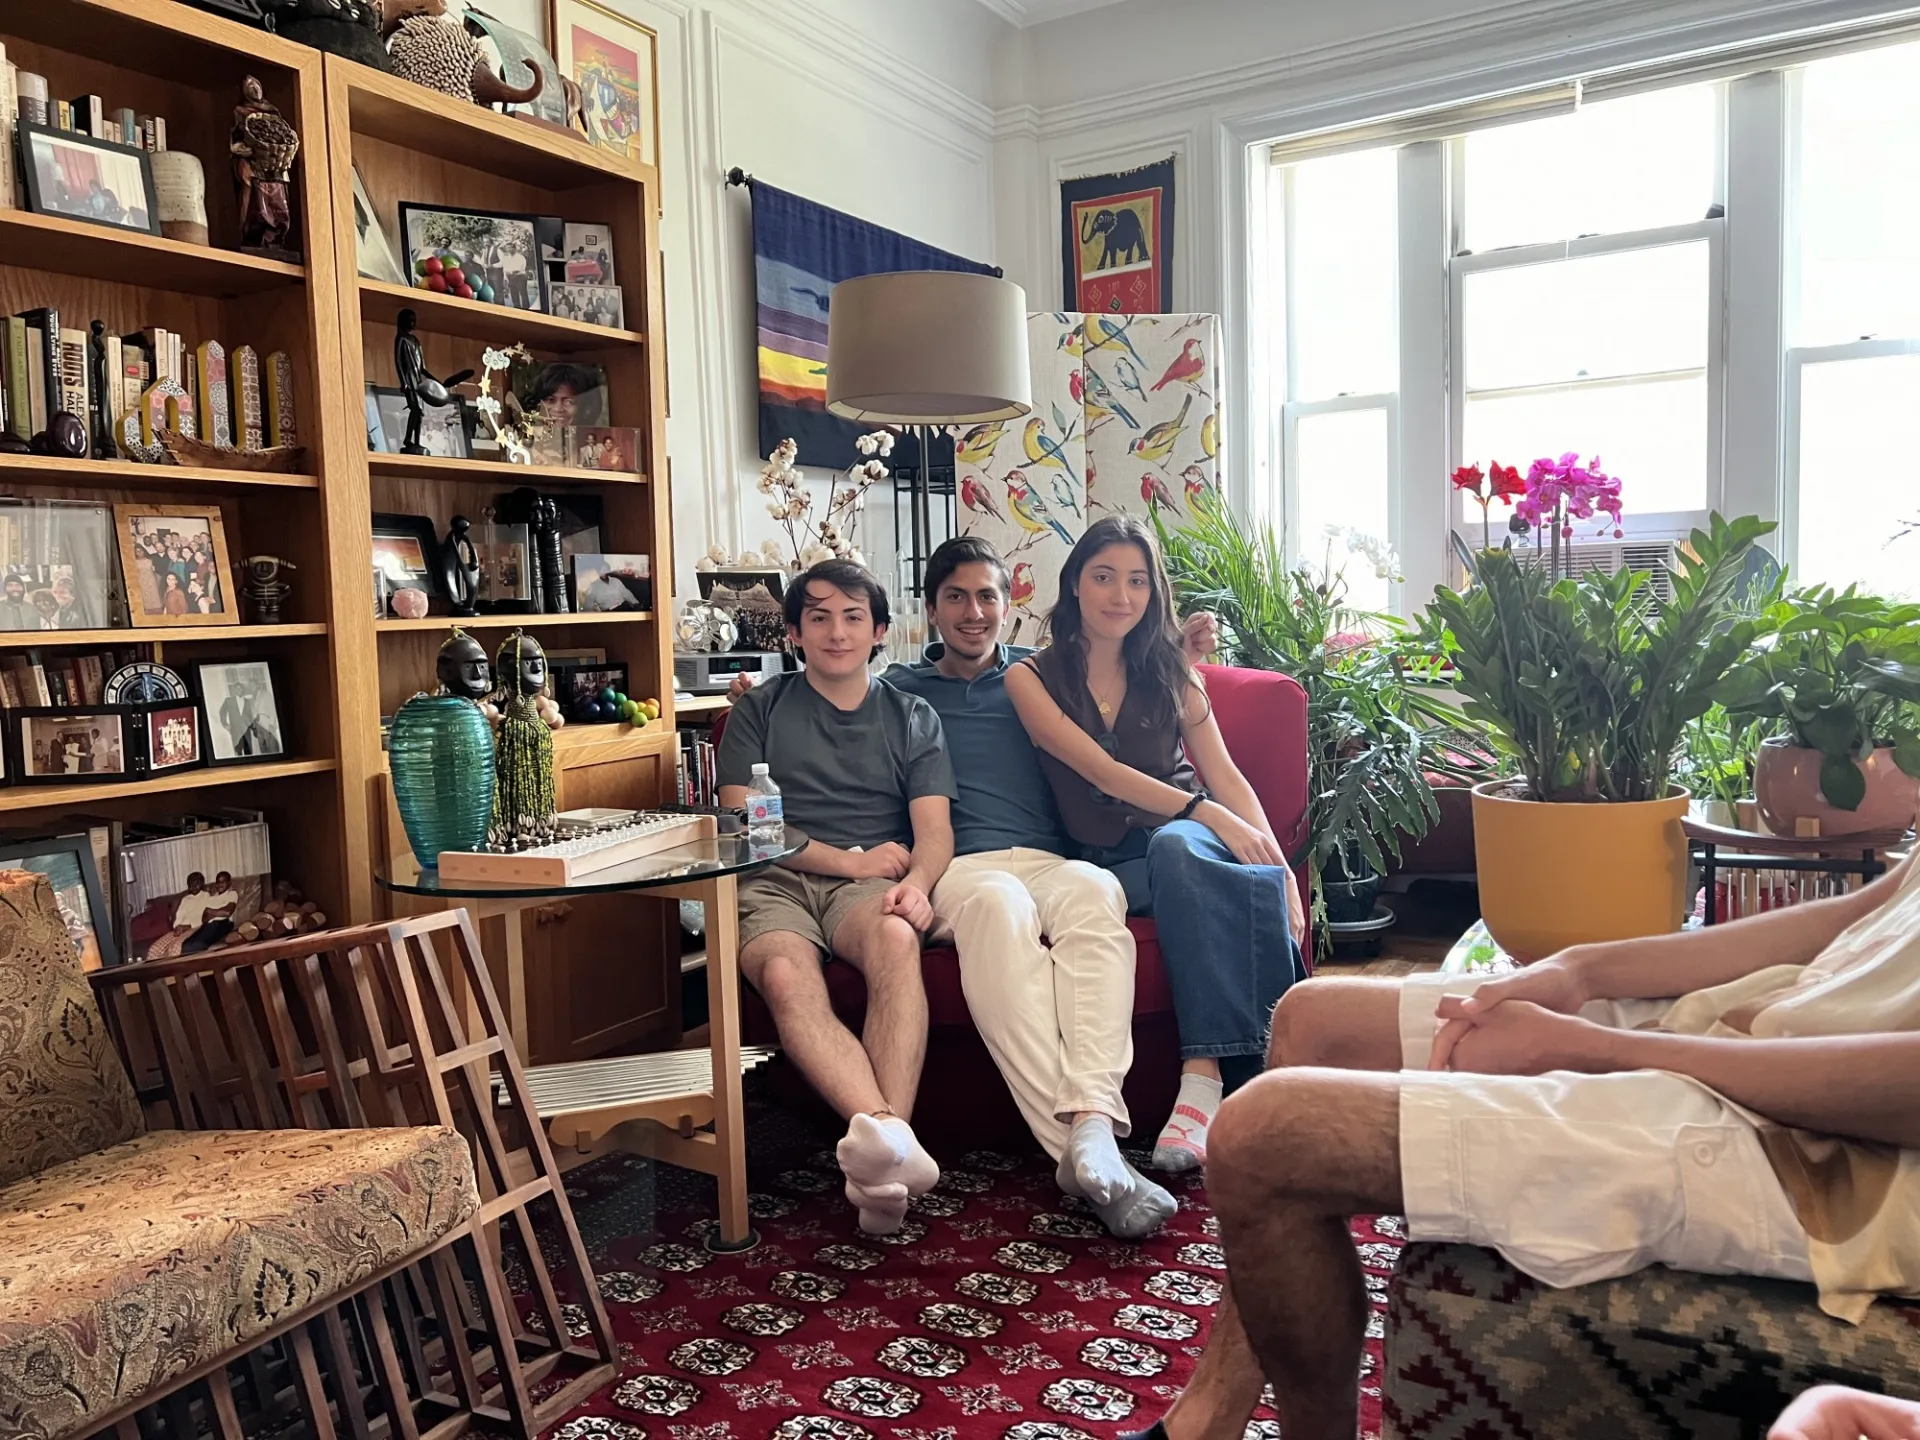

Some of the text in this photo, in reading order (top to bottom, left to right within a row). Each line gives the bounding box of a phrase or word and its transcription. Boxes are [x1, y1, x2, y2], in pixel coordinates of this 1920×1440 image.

[62, 342, 85, 388] ROOTS
[66, 391, 75, 413] HAL
[75, 392, 85, 421] ALEX
